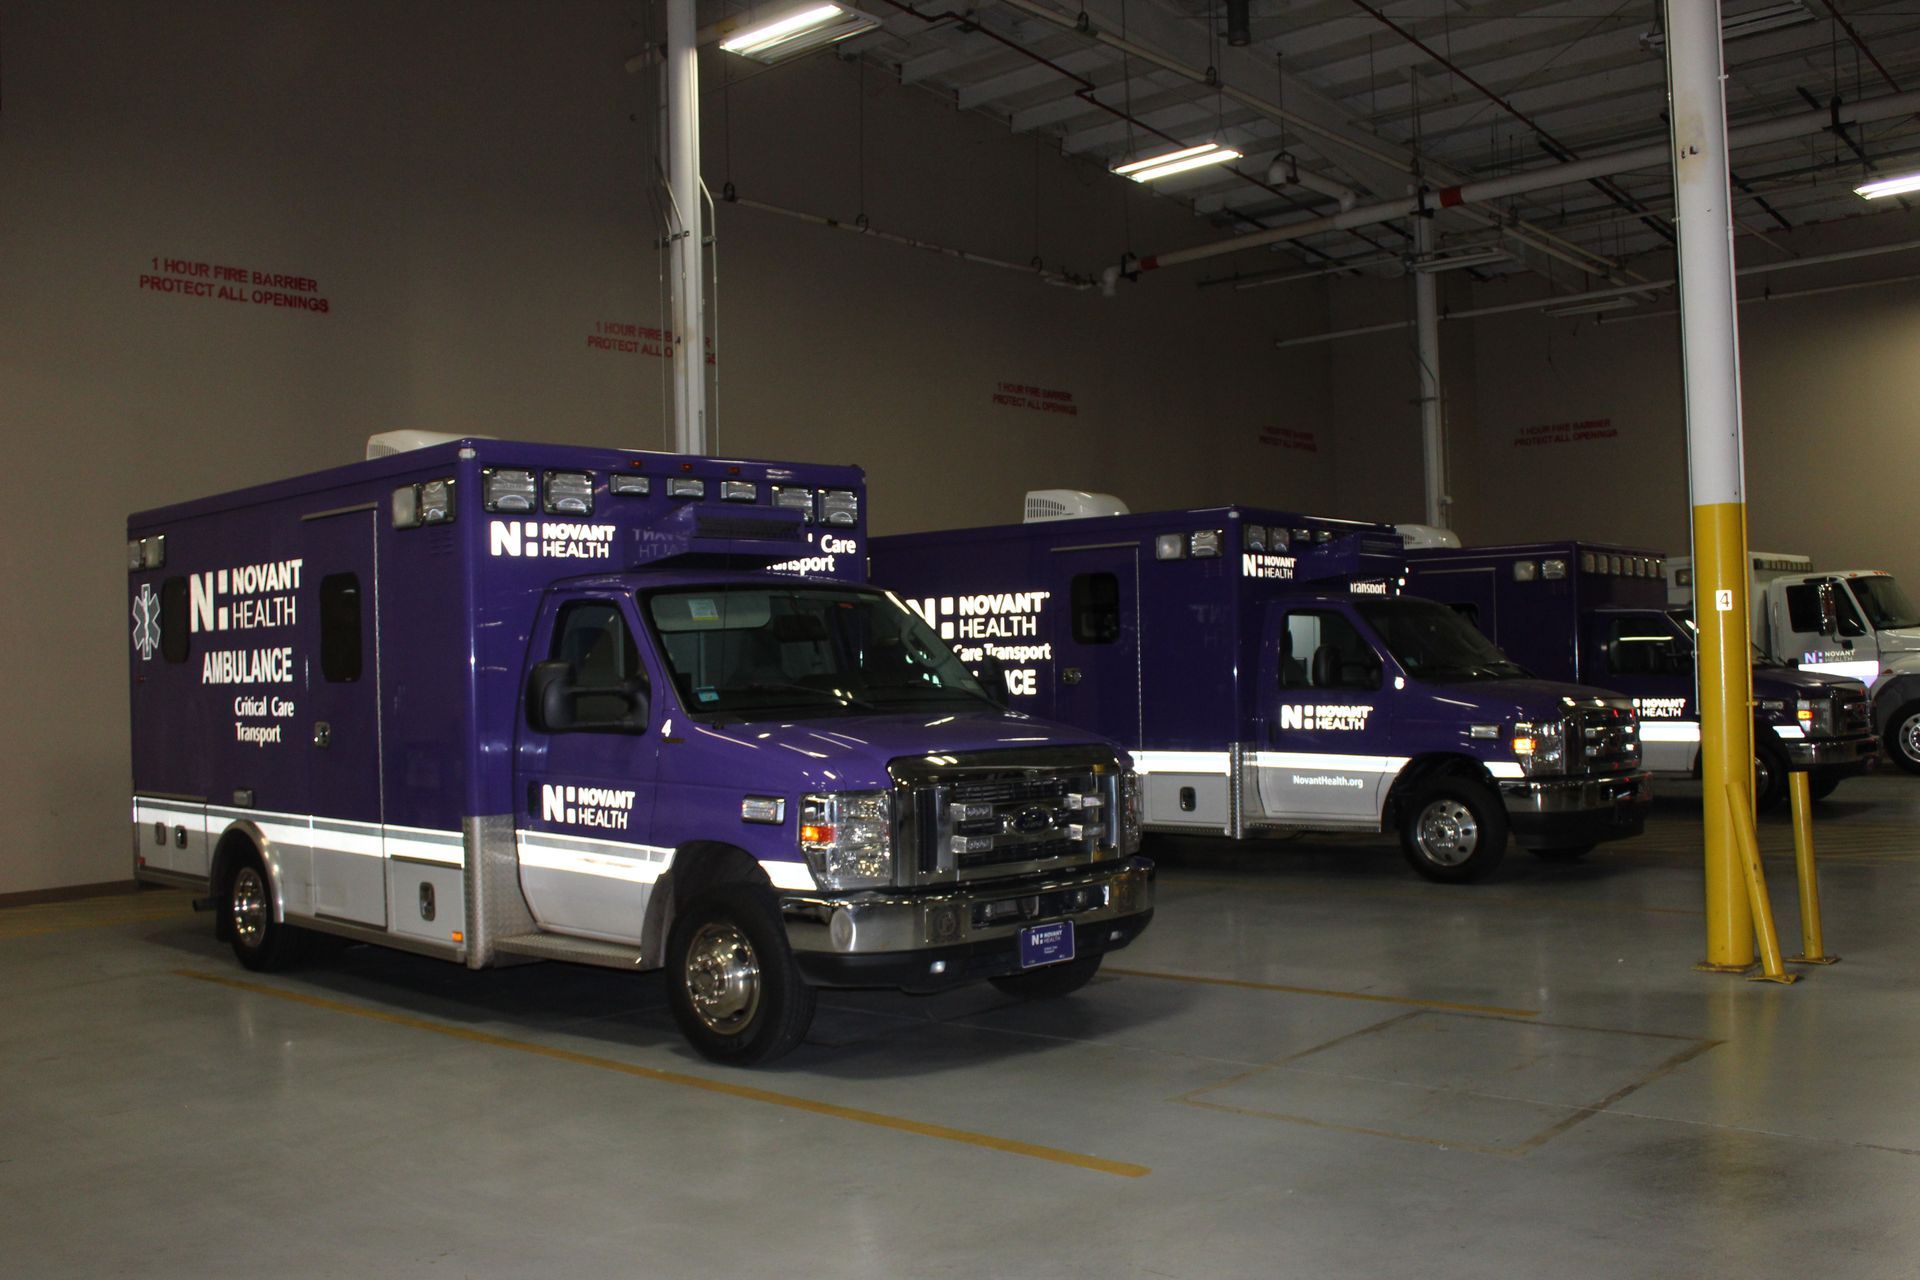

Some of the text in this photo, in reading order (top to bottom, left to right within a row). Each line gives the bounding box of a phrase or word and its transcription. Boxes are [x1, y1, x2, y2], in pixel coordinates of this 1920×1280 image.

[152, 257, 318, 292] 1 HOUR FIRE BARRIER
[139, 274, 329, 313] PROTECT ALL OPENINGS
[604, 322, 636, 337] HOUR
[638, 326, 662, 341] FIRE
[587, 335, 639, 354] PROTECT
[641, 344, 662, 358] ALL
[992, 393, 1026, 408] PROTECT
[1027, 400, 1040, 410] ALL
[1554, 433, 1570, 443] ALL
[542, 523, 616, 542] NOVANT
[542, 540, 609, 558] HEALTH
[820, 534, 856, 555] Care
[1264, 555, 1295, 568] NOVANT
[232, 558, 303, 595] NOVANT
[1264, 567, 1293, 579] HEALTH
[959, 592, 1044, 616] NOVANT
[1720, 592, 1730, 608] 4
[233, 595, 296, 629] HEALTH
[959, 616, 1037, 639] HEALTH
[983, 642, 1052, 664] Transport
[1824, 649, 1855, 657] NOVANT
[202, 647, 293, 684] AMBULANCE
[234, 696, 295, 717] Critical Care
[1316, 705, 1371, 718] NOVANT
[1642, 698, 1686, 708] NOVANT
[1642, 707, 1682, 717] HEALTH
[661, 719, 672, 738] 4
[1316, 718, 1364, 730] HEALTH
[235, 722, 281, 747] Transport
[1293, 774, 1364, 789] NovantHealth.org
[578, 787, 636, 810] NOVANT
[578, 808, 628, 829] HEALTH
